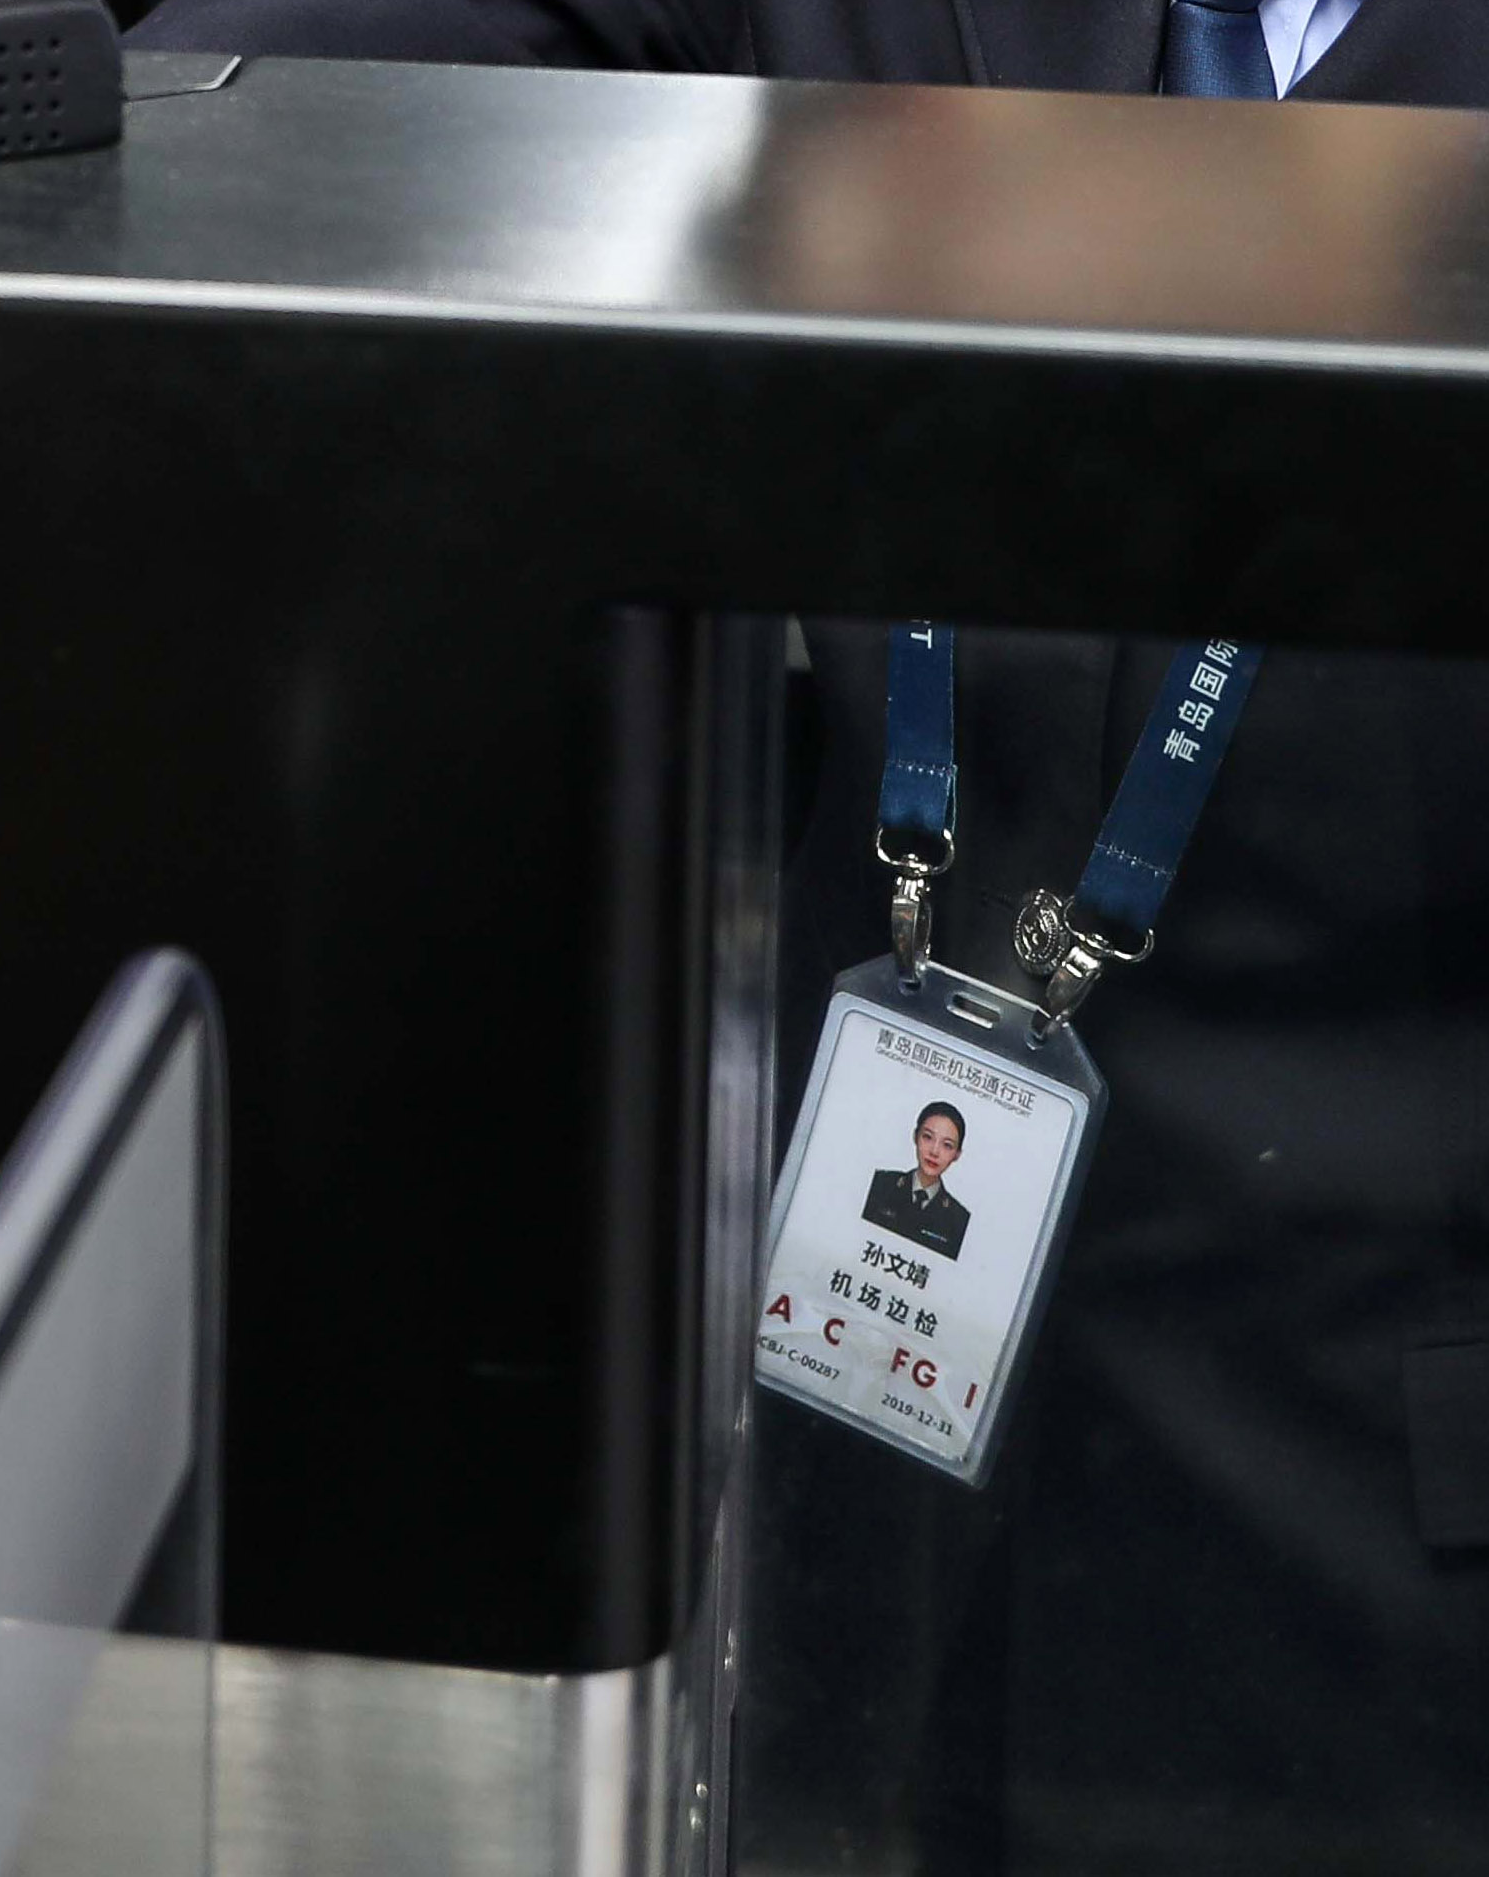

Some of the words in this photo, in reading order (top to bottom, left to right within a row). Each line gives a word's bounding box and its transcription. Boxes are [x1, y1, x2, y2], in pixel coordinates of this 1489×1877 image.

[876, 1027, 1037, 1111] 青岛国际机场通行证
[765, 1293, 792, 1323] A
[822, 1317, 846, 1347] C
[829, 1269, 939, 1338] 机场边检
[881, 1393, 954, 1437] 2019-12-31
